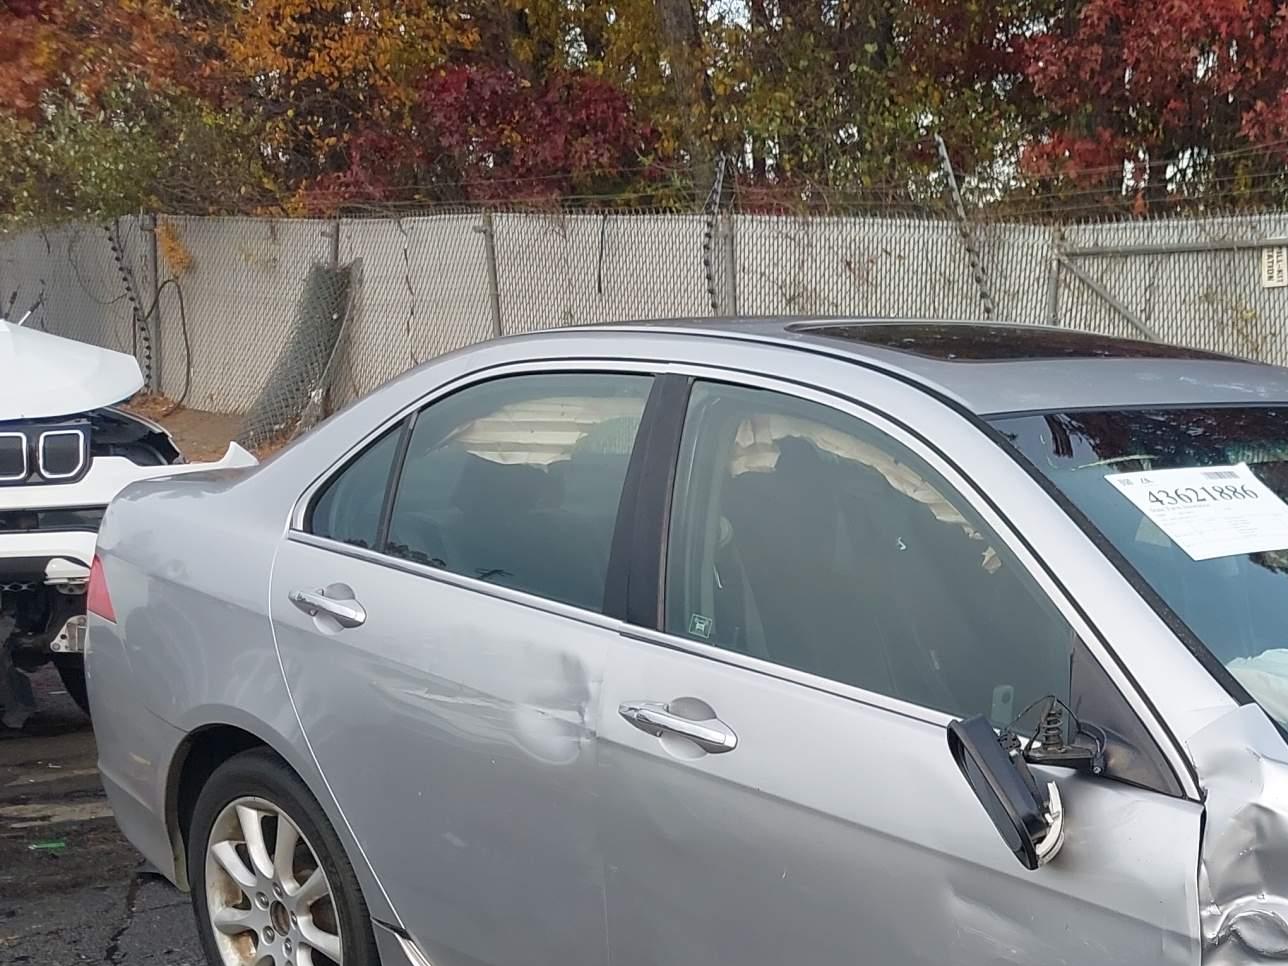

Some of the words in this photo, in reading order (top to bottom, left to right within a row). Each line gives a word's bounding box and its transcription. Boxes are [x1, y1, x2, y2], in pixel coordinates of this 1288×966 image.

[1267, 248, 1275, 282] TATION
[1276, 247, 1285, 283] ILL-KIT
[1147, 483, 1260, 507] 43621886
